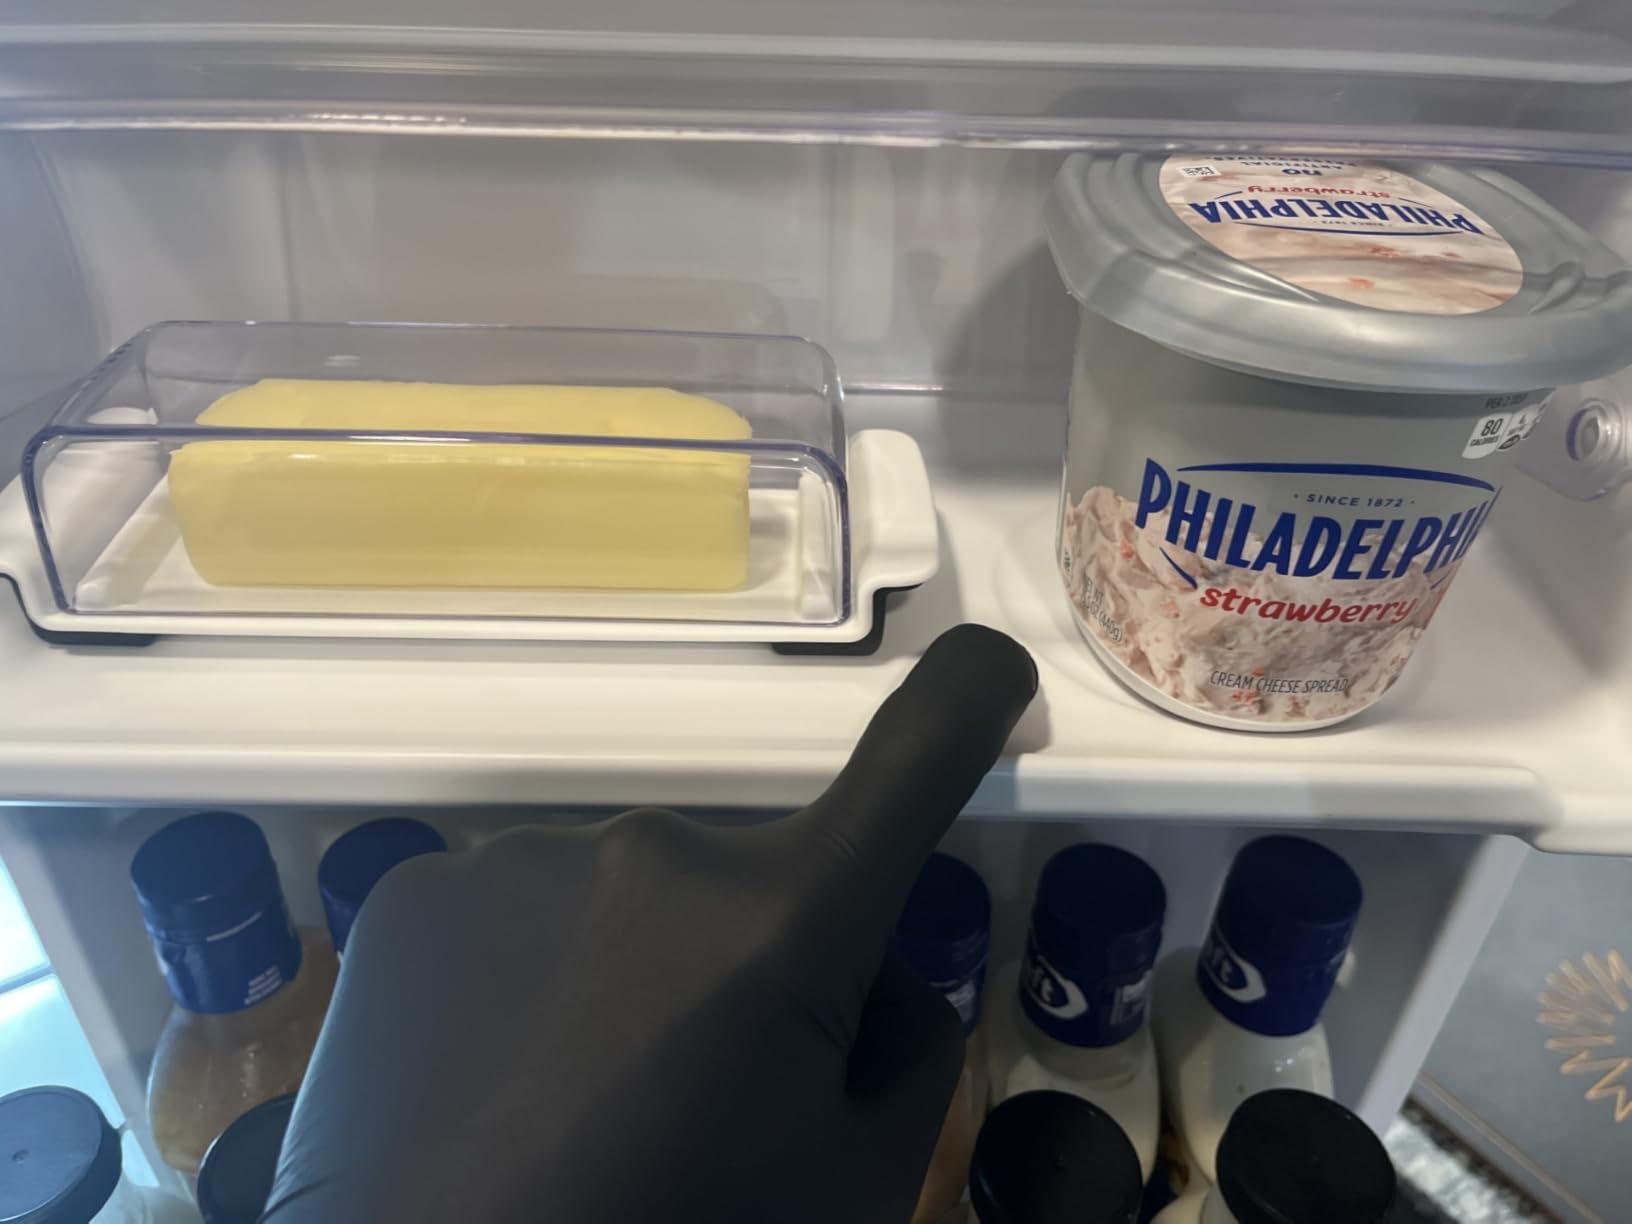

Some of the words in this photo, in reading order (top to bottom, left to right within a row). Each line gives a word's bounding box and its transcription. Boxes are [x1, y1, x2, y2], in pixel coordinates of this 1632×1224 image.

[1281, 167, 1323, 177] no
[1247, 184, 1392, 199] strawberry
[1187, 198, 1485, 236] PHILADELPHIA
[1481, 418, 1504, 437] 80
[1306, 493, 1360, 507] SINCE
[1367, 497, 1403, 508] 1872
[1200, 586, 1418, 625] strawberry
[1210, 670, 1253, 690] CREAM
[1256, 677, 1302, 694] CHEESE
[1302, 678, 1350, 694] SPREAD
